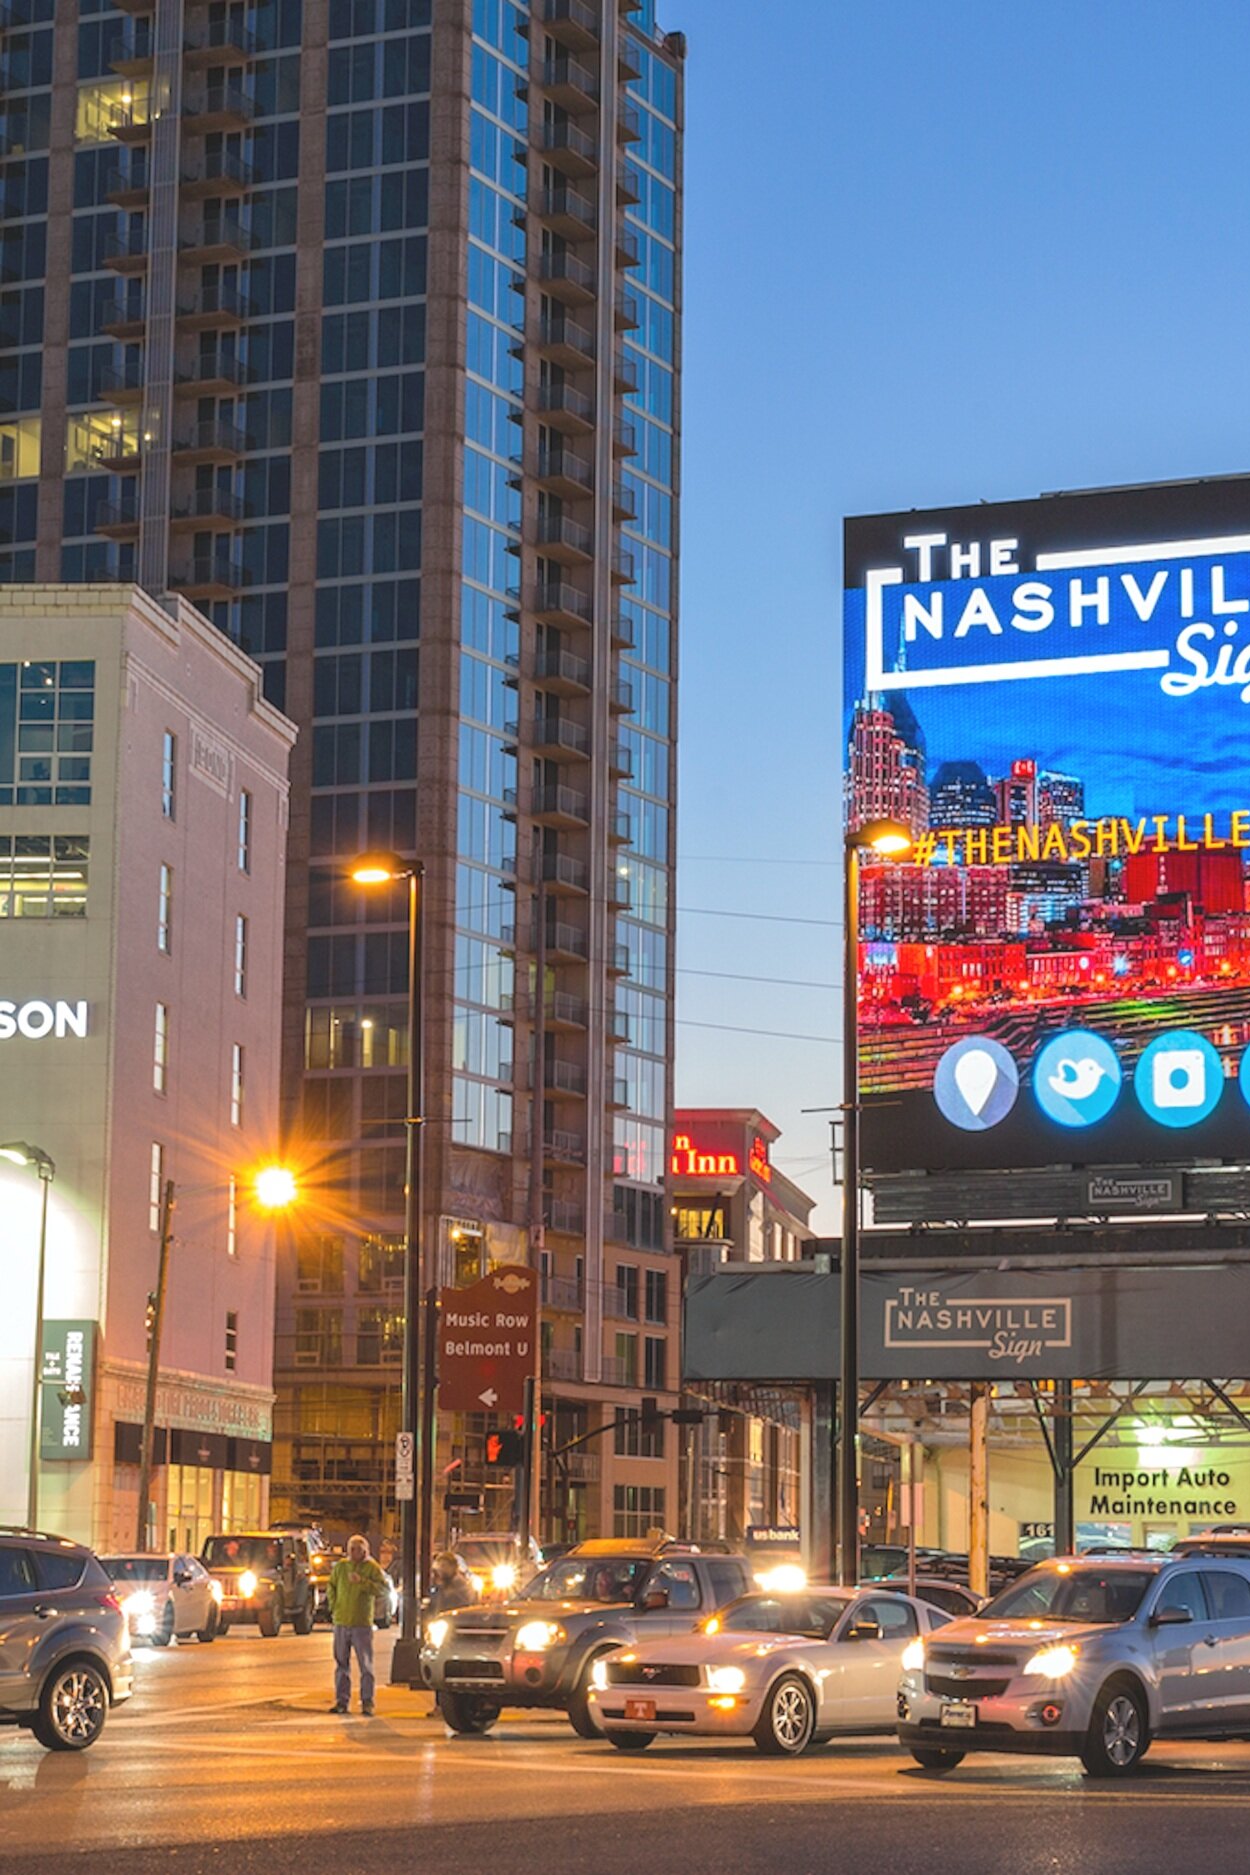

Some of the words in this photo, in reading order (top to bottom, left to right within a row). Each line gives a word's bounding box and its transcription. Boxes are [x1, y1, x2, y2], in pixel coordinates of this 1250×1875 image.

[904, 533, 1019, 583] THE
[0, 1000, 87, 1039] SON
[686, 1149, 737, 1174] Inn
[1094, 1184, 1165, 1196] NASHVILLE
[898, 1287, 940, 1306] THE
[445, 1312, 490, 1328] Music
[495, 1312, 529, 1328] Row
[898, 1309, 1057, 1329] NASHVILLE
[445, 1341, 511, 1356] Belmont
[517, 1341, 529, 1357] U
[988, 1331, 1042, 1364] Sign
[1094, 1467, 1169, 1492] Import
[1176, 1467, 1231, 1487] Auto
[1090, 1495, 1237, 1515] Maintenance
